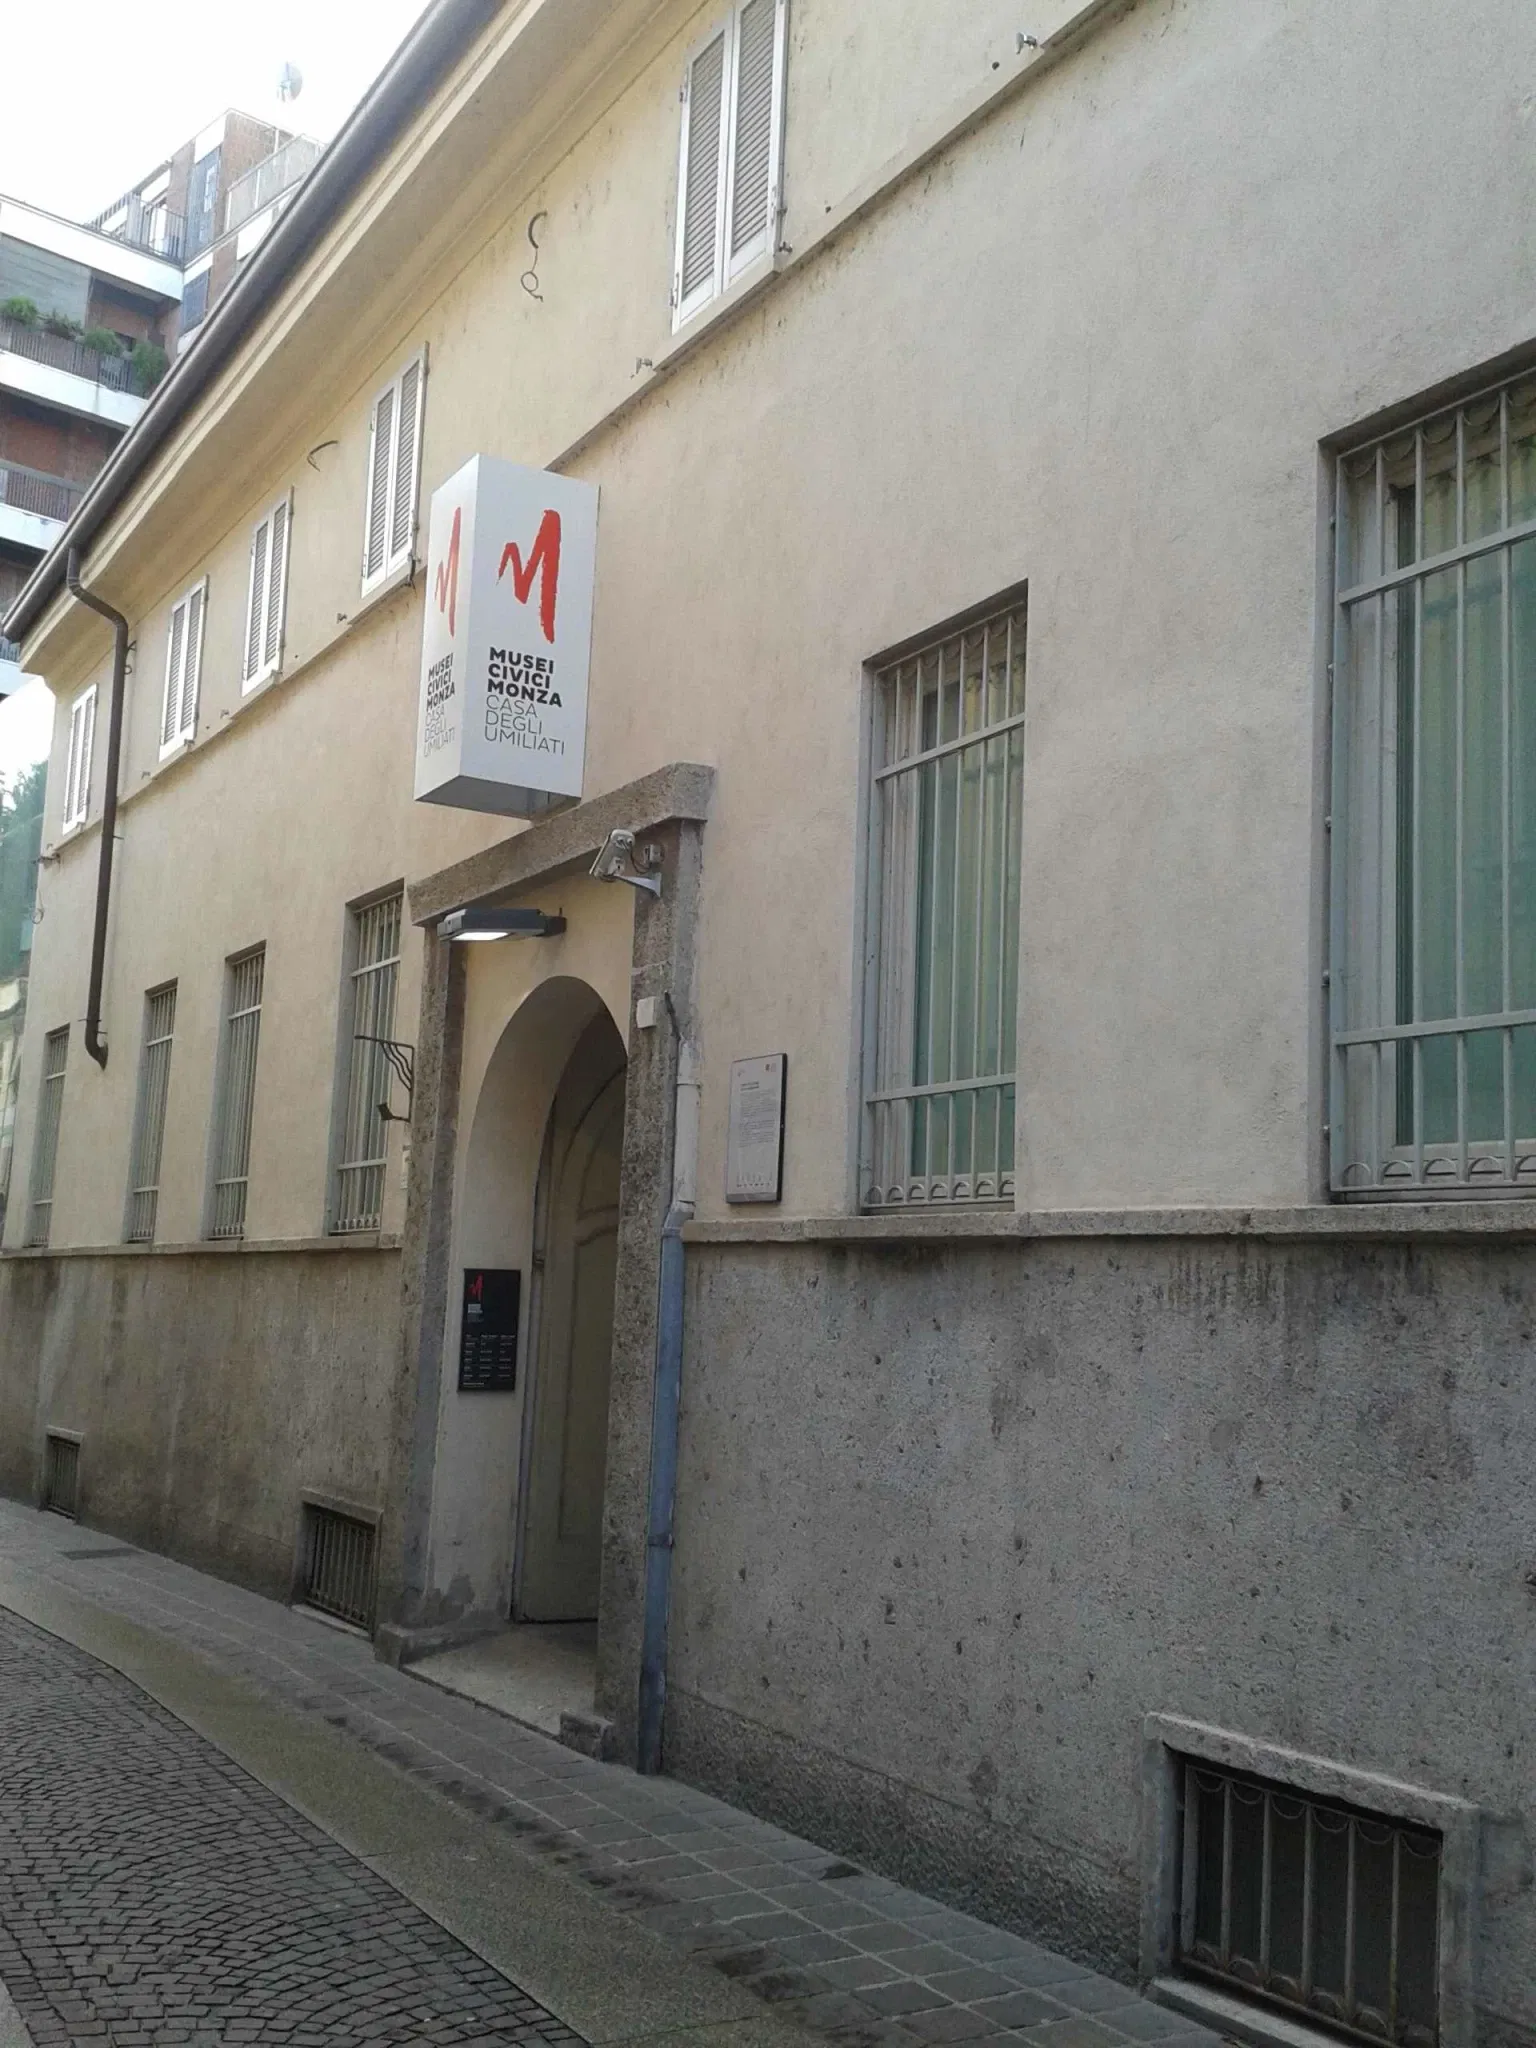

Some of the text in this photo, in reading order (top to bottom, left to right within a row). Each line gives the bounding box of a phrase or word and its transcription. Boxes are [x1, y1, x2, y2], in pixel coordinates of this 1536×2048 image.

[428, 652, 454, 681] MUSEI
[489, 646, 554, 674] MUSEI
[427, 669, 452, 696] CIVICI
[488, 663, 551, 689] CIVICI
[426, 681, 456, 712] MONZA
[486, 694, 538, 719] CASA
[487, 678, 562, 708] MONZA
[425, 704, 445, 727] CASA
[485, 709, 542, 735] DEGLI
[484, 725, 565, 756] UMILIATI
